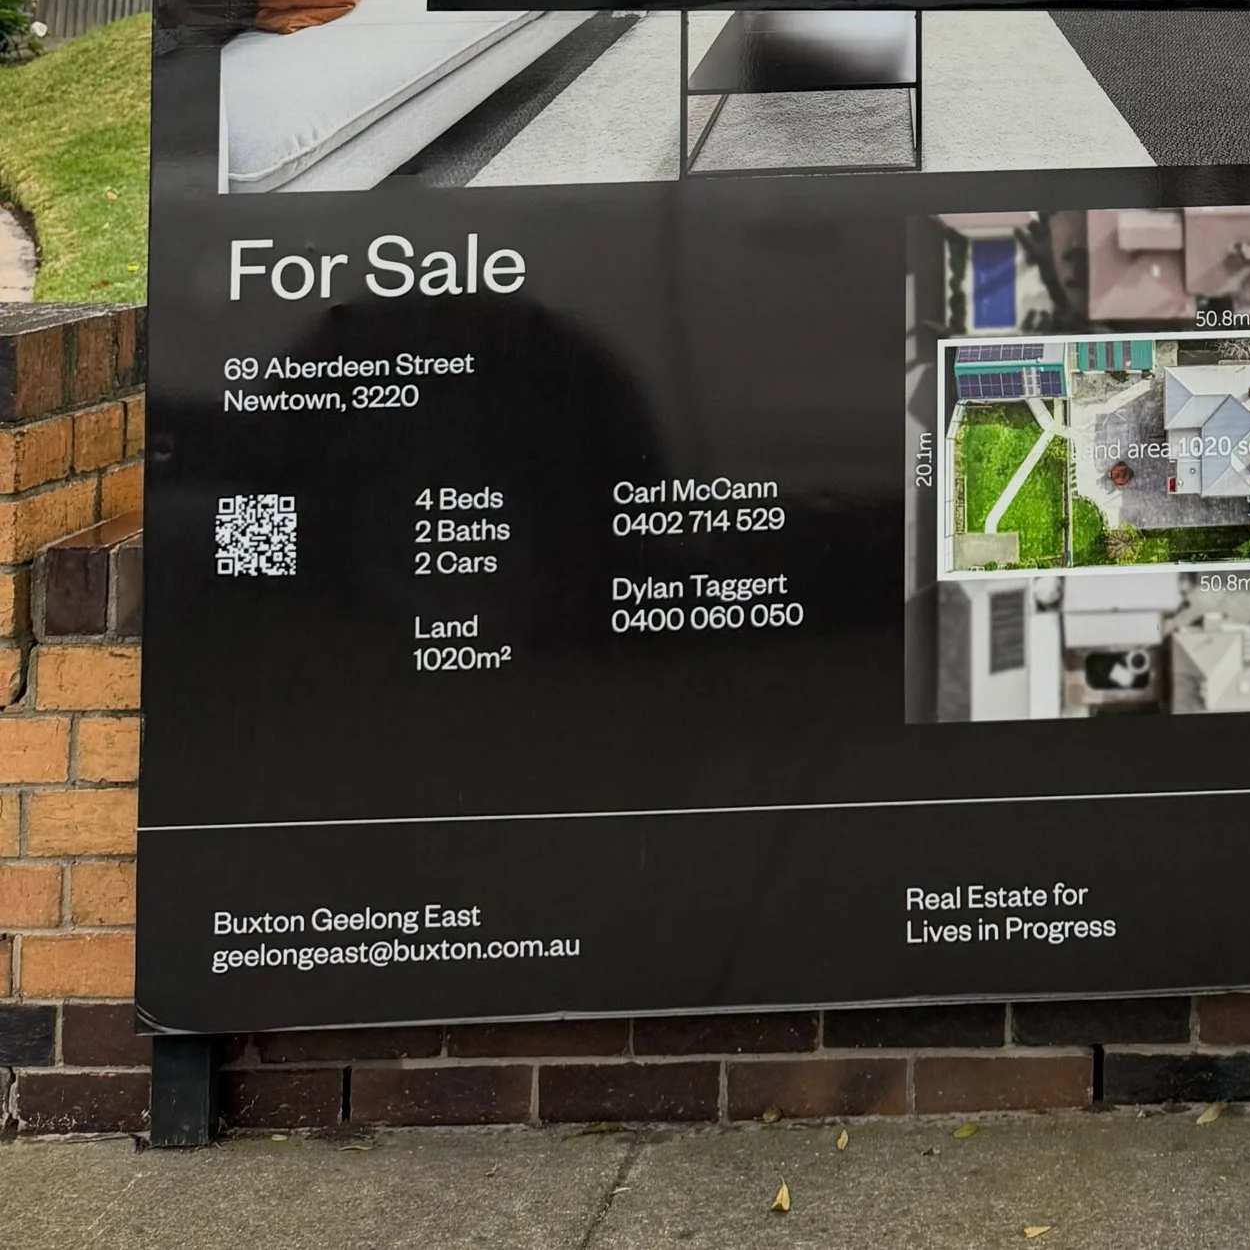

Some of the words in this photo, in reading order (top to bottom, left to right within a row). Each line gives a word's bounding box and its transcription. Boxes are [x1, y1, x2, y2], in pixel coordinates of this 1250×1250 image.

[229, 238, 349, 301] For
[364, 233, 526, 298] Sale
[1195, 309, 1250, 327] 50.8m
[223, 356, 260, 382] 69
[263, 354, 390, 380] Aberdeen
[394, 352, 476, 377] Street
[223, 388, 347, 414] Newtown,
[351, 383, 420, 410] 3220
[915, 432, 932, 487] 20.1m
[1127, 442, 1171, 459] area
[1178, 435, 1232, 457] 1020
[414, 487, 435, 512] 4
[438, 485, 504, 511] Beds
[612, 479, 667, 505] Carl
[671, 476, 778, 503] McCann
[414, 519, 433, 544] 2
[436, 517, 511, 543] Baths
[611, 510, 684, 537] 0402
[687, 508, 732, 534] 714
[735, 506, 786, 532] 529
[413, 551, 432, 576] 2
[435, 550, 498, 575] Cars
[611, 575, 684, 606] Dylan
[688, 573, 789, 603] Taggert
[414, 614, 479, 640] Land
[610, 606, 685, 634] 0400
[689, 604, 745, 631] 060
[749, 601, 805, 628] 050
[412, 644, 513, 672] 1020m²
[906, 885, 962, 912] Real
[967, 884, 1048, 909] Estate
[1051, 881, 1089, 907] for
[213, 911, 305, 936] Buxton
[310, 906, 420, 934] Geelong
[424, 903, 482, 929] East
[906, 919, 973, 944] Lives
[977, 917, 1000, 942] in
[1005, 916, 1117, 943] Progress
[211, 937, 581, 973] geelongeast@buxton.com.au
